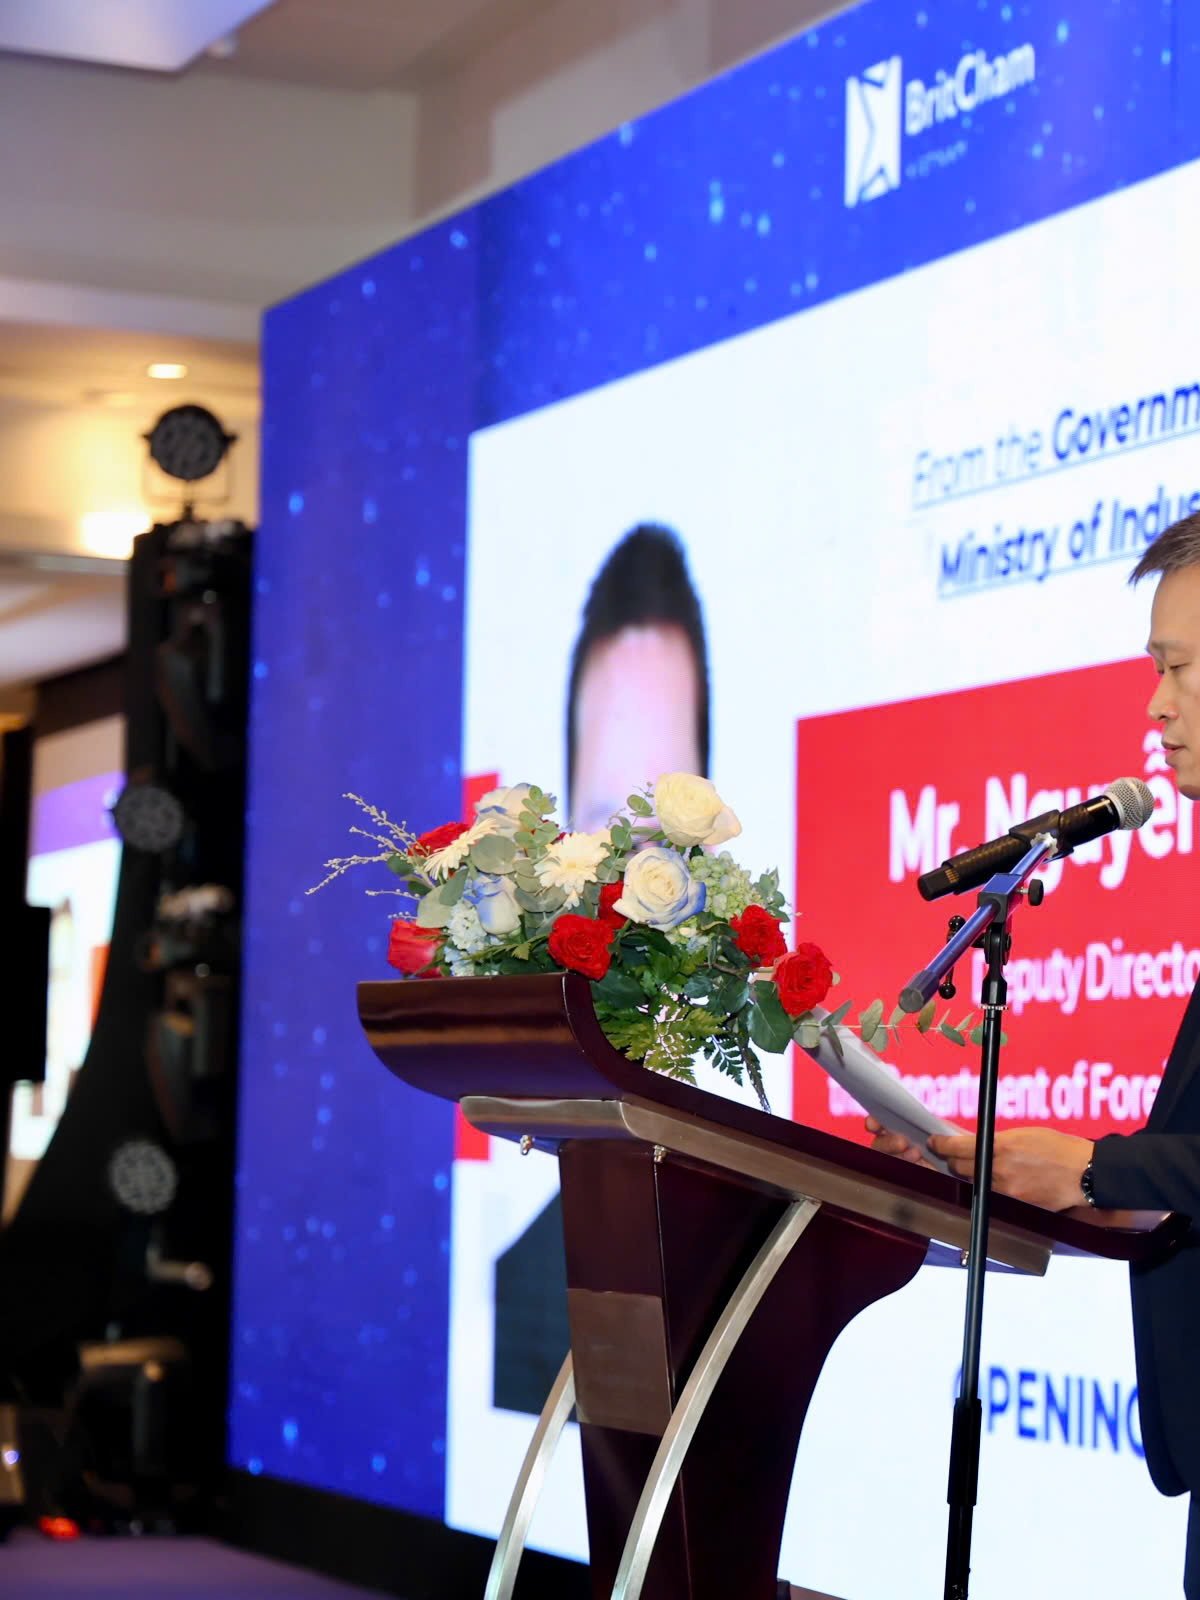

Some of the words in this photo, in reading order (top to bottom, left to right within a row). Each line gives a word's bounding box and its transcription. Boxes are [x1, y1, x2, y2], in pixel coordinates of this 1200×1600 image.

[913, 448, 986, 496] From
[995, 424, 1042, 479] the
[938, 523, 1059, 587] Ministry
[1068, 500, 1103, 562] of
[1051, 1059, 1088, 1120] of
